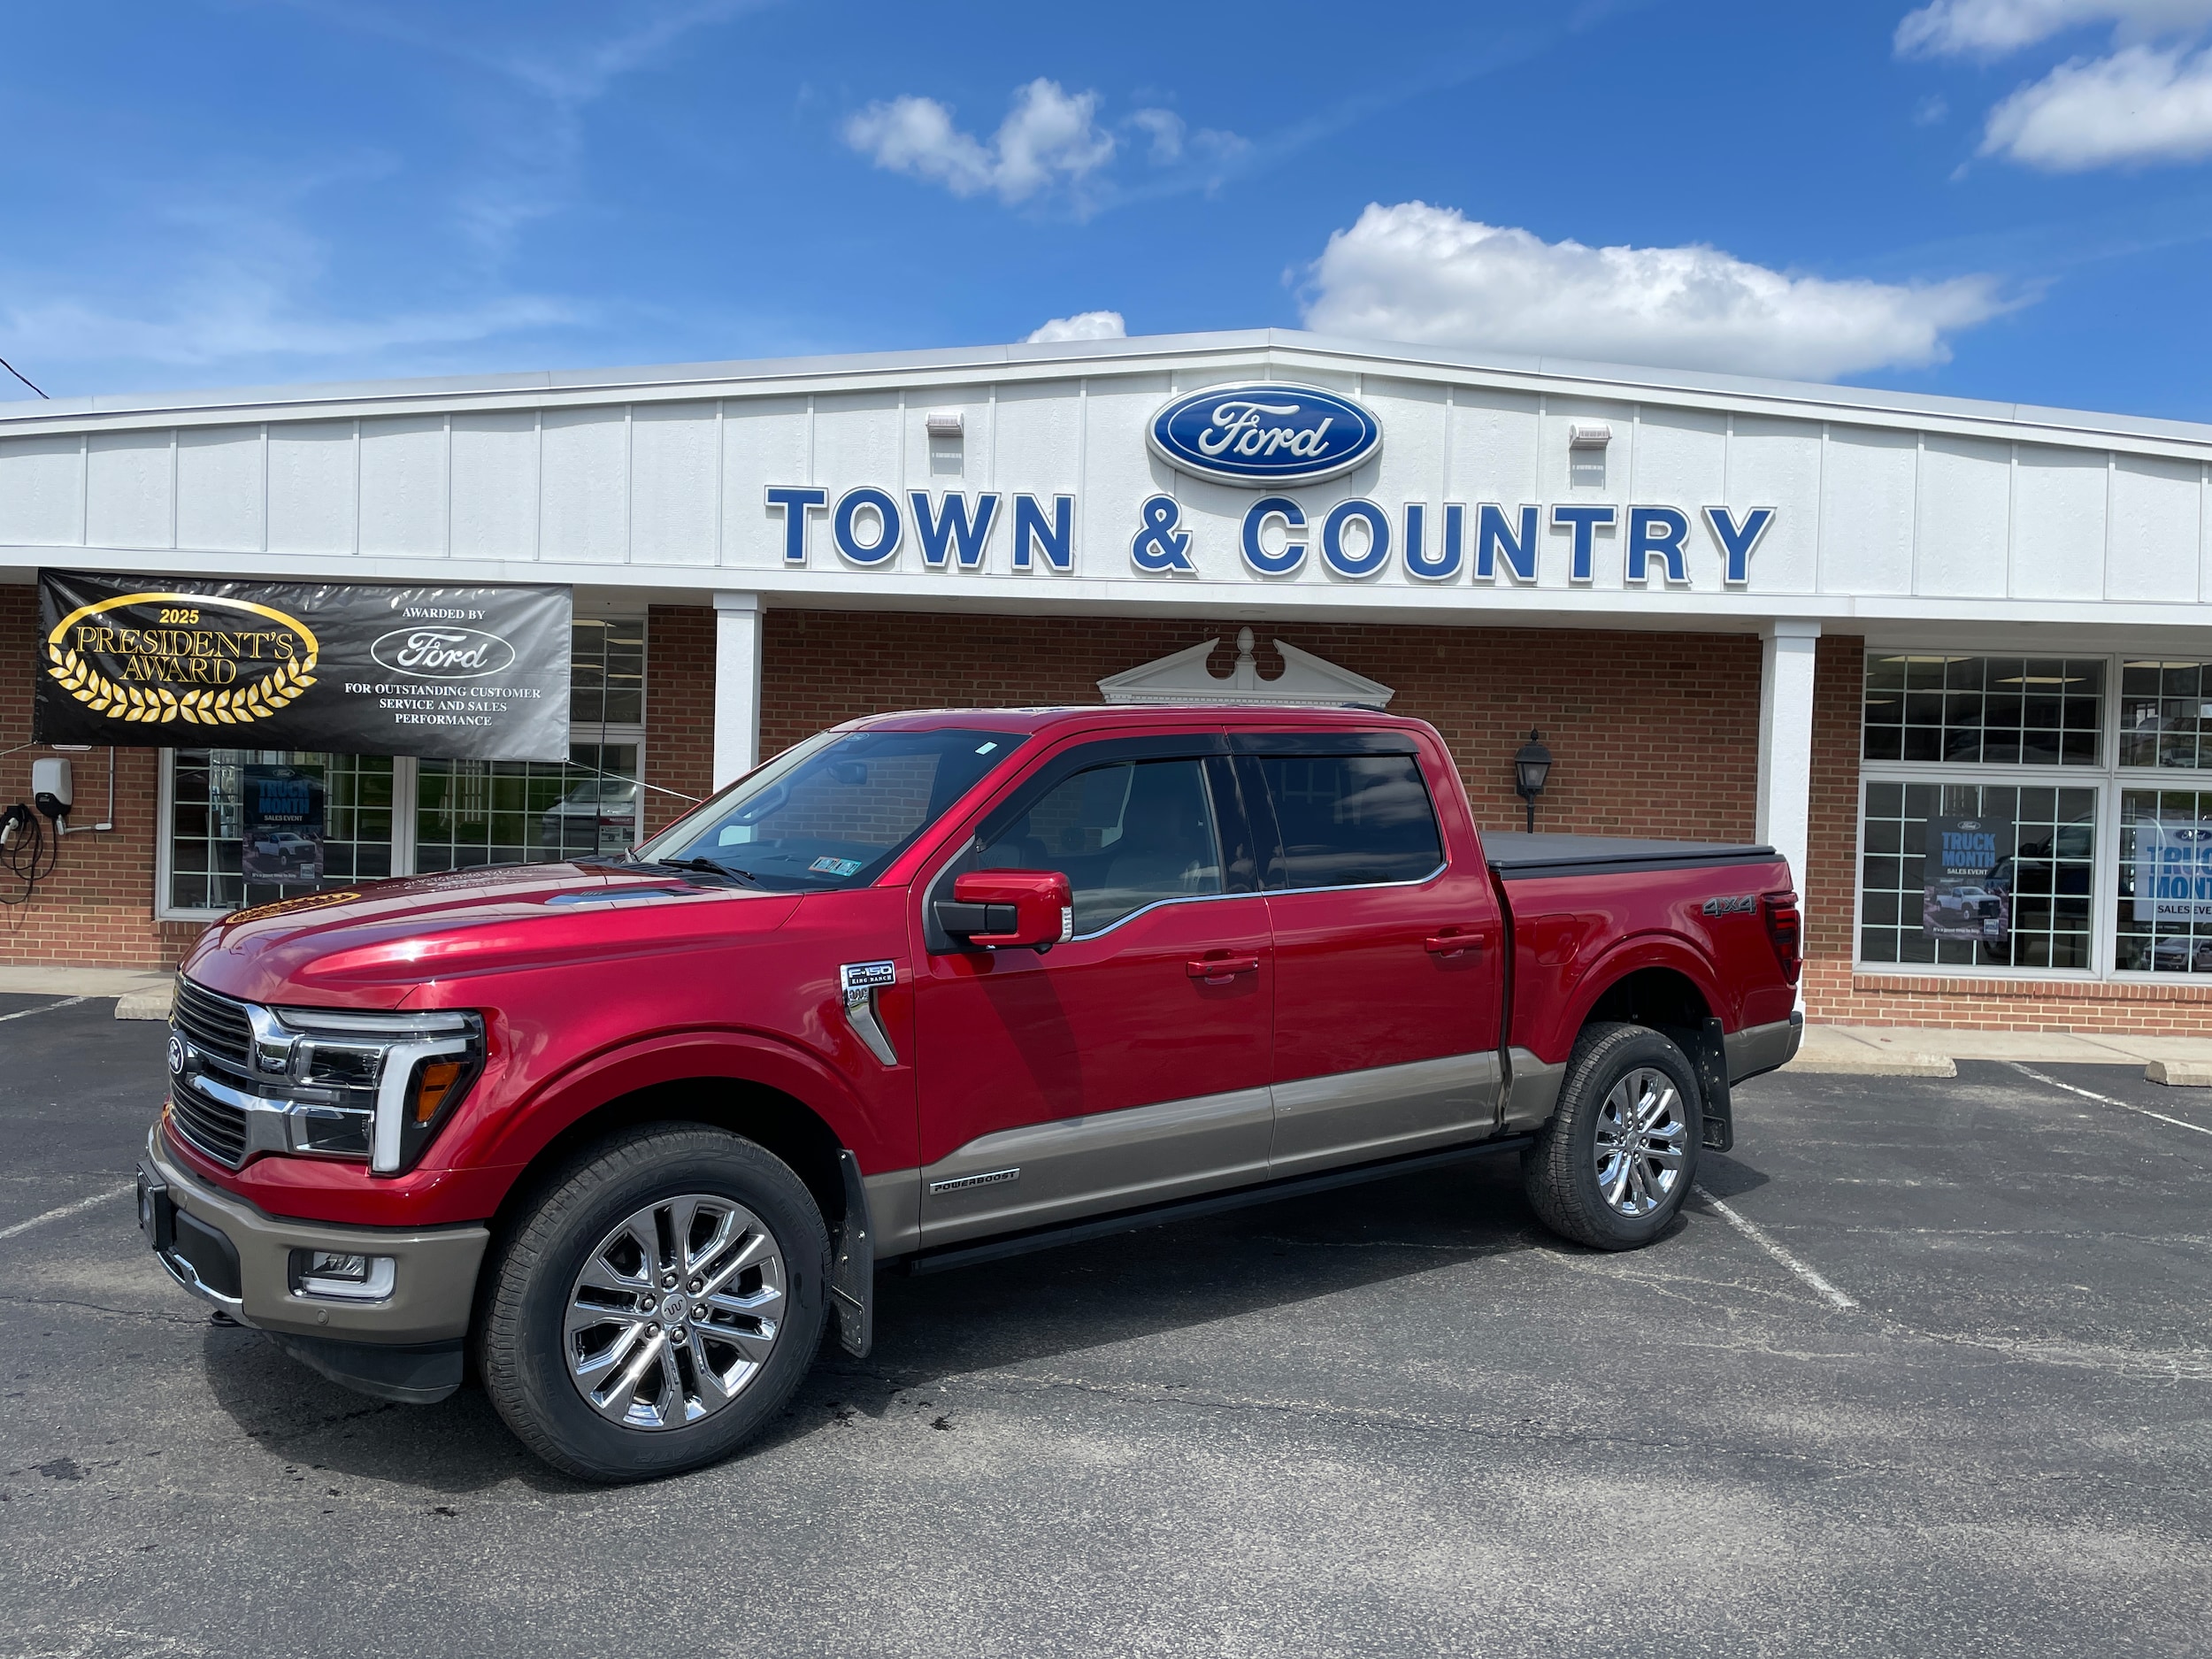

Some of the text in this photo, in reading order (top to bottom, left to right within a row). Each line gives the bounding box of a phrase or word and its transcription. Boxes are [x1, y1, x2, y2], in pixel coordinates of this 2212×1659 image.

[1198, 400, 1333, 457] Ford
[764, 486, 1778, 585] TOWN & COUNTRY
[159, 609, 199, 625] 2025
[403, 608, 486, 619] AWARDED BY
[76, 626, 293, 660] PRESIDENT'S
[396, 632, 488, 669] Ford
[119, 656, 237, 685] AWARD
[344, 682, 541, 699] FOR OUTSTANDING CUSTOMER
[379, 698, 507, 712] SERVICE AND SALES
[395, 713, 492, 726] PERFORMANCE
[258, 797, 310, 813] MONTH
[1941, 832, 1995, 850] TRUCK
[1942, 850, 1995, 867] MONTH
[2157, 904, 2190, 914] SALES
[849, 965, 893, 978] F-150
[934, 1171, 1016, 1192] POWERBOOST
